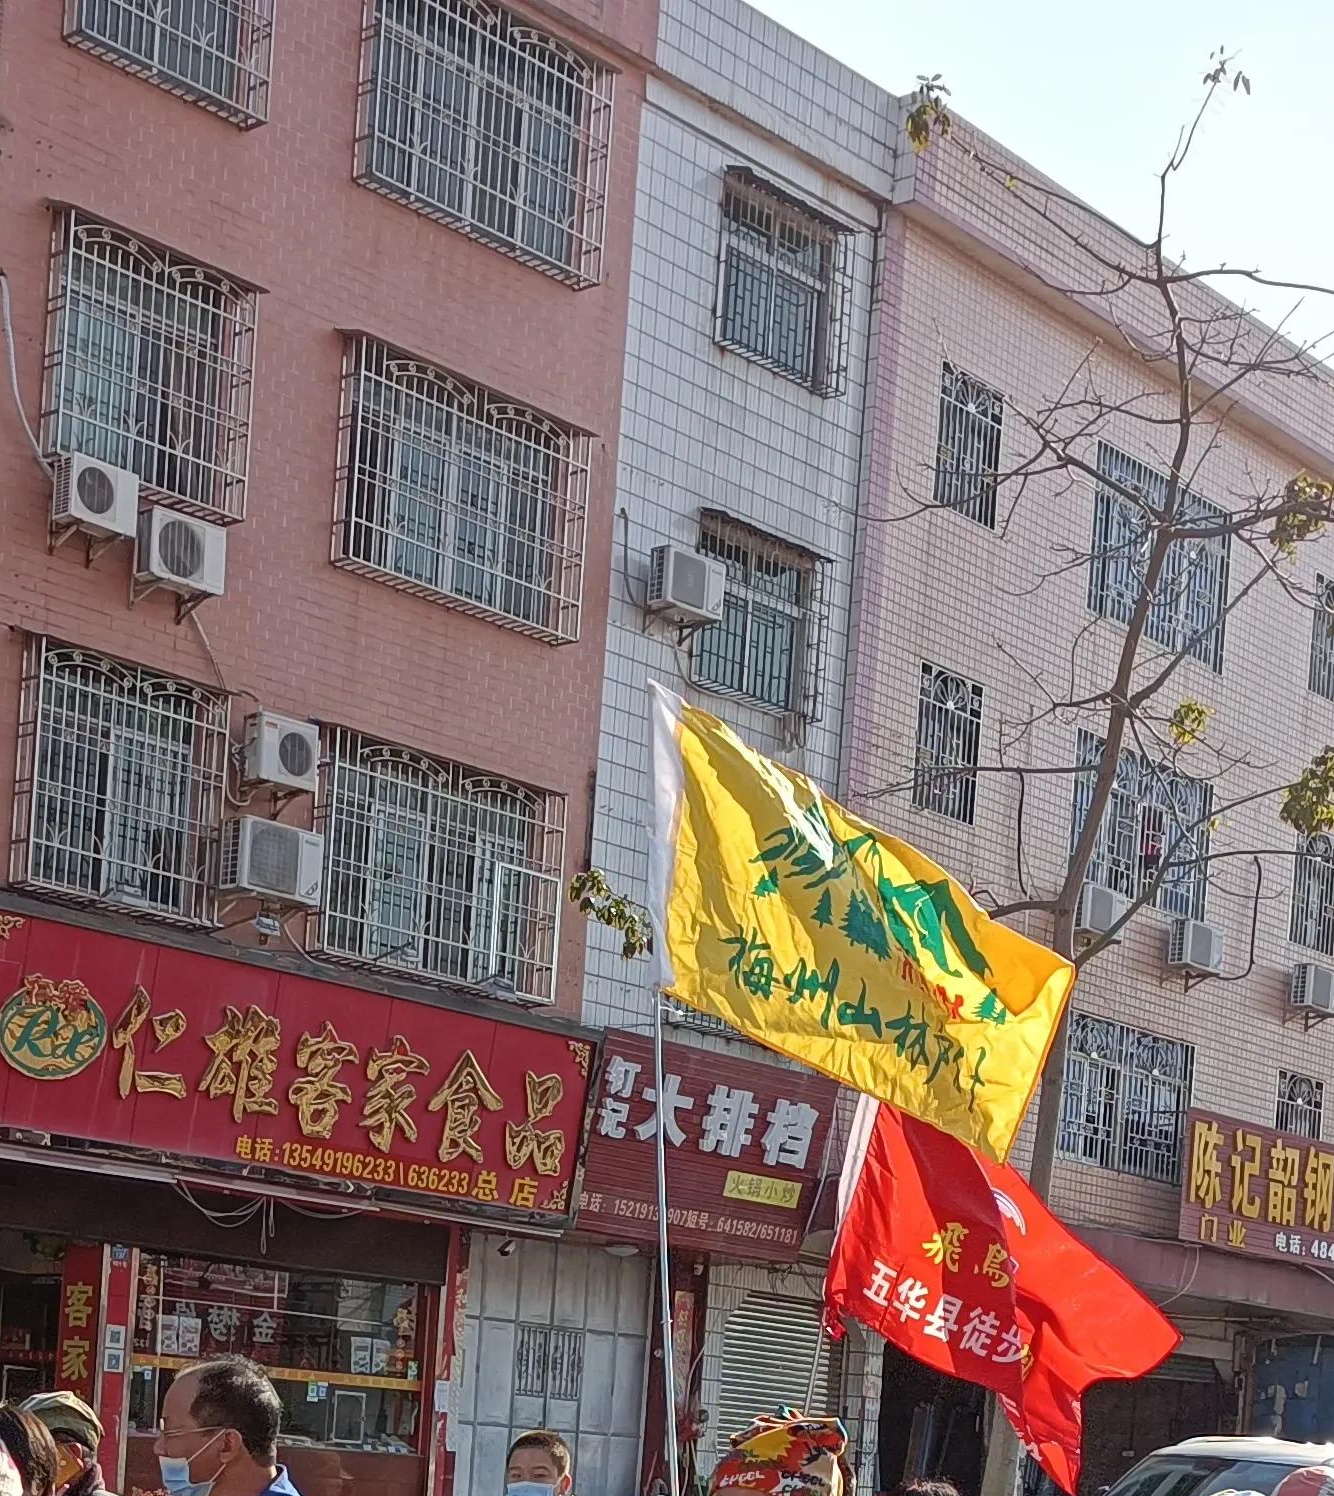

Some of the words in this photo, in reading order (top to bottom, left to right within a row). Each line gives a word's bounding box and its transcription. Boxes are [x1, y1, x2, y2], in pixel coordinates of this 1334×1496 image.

[112, 984, 567, 1176] 仁雄客家食品
[634, 1074, 820, 1170] 大排档
[1199, 1213, 1247, 1249] 门业
[61, 1281, 93, 1399] 客家
[863, 1259, 1025, 1363] 五华县徒步
